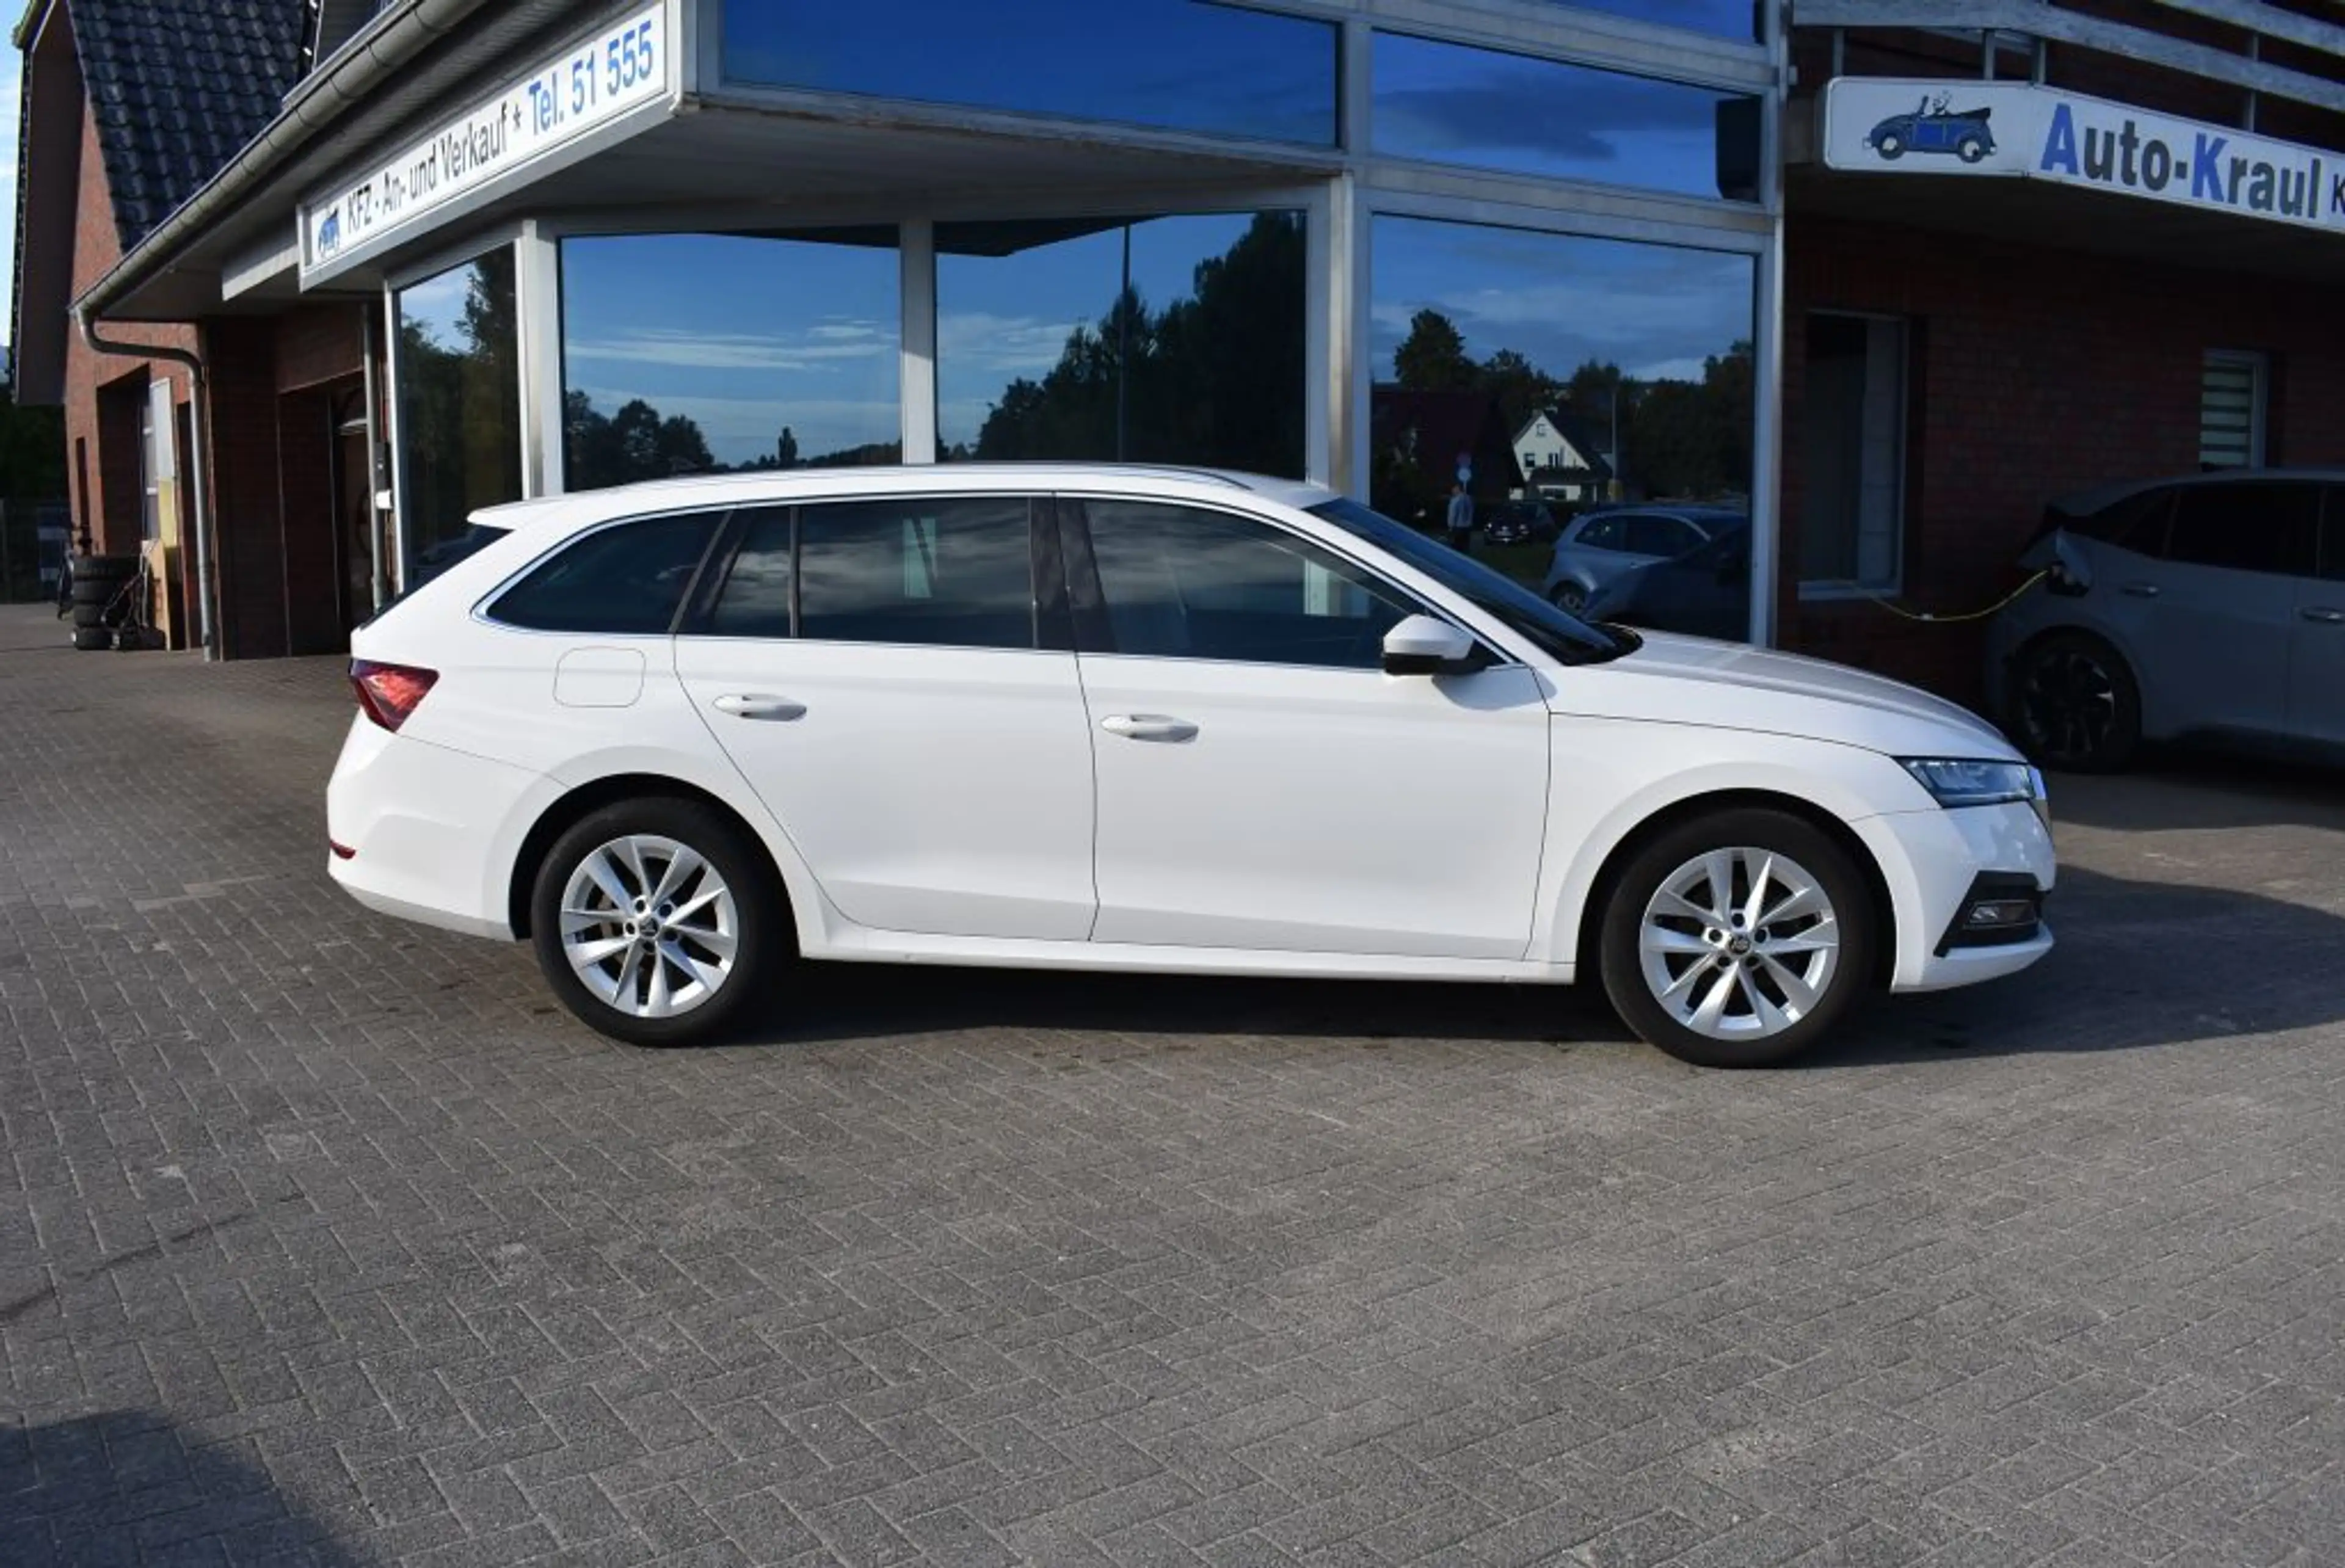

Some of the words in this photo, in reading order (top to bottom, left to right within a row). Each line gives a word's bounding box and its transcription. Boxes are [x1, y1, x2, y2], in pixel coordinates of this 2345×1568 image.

[347, 183, 372, 234] KFZ
[410, 143, 437, 200] und
[440, 100, 507, 181] Verkauf
[529, 70, 564, 136] Tel.
[572, 49, 596, 114] 51
[607, 20, 653, 96] 555
[2040, 103, 2321, 219] Auto-Kraul
